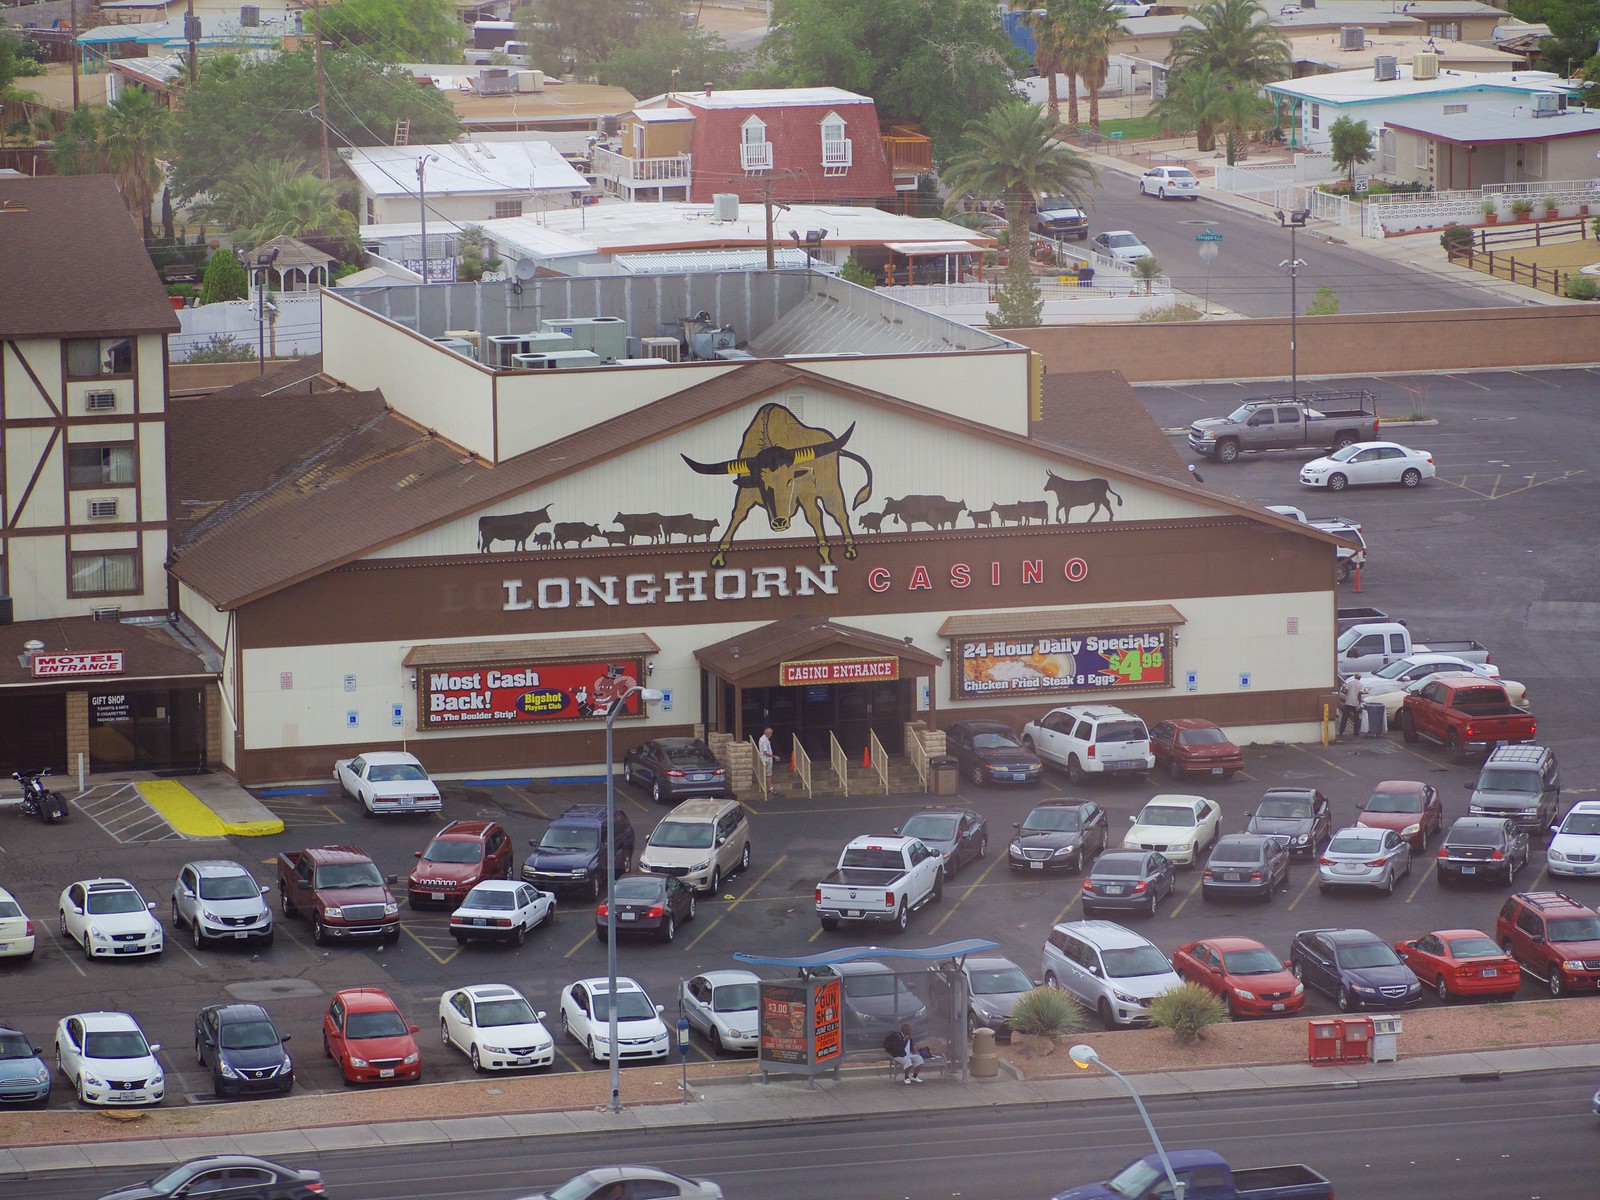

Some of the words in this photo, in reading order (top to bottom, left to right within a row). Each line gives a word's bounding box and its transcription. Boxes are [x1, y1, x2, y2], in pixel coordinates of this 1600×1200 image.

[502, 564, 839, 611] LONGHORN
[868, 558, 1088, 592] CASINO
[964, 642, 1034, 658] 24-Hour
[1038, 637, 1082, 655] Daily
[1086, 633, 1165, 654] Specials!
[39, 655, 118, 665] MOTEL
[39, 663, 118, 672] ENTRANCE
[788, 667, 828, 680] CASINO
[833, 663, 891, 677] ENTRANCE
[430, 672, 482, 691] Most
[487, 669, 540, 689] Cash
[964, 680, 1008, 691] Chicken
[1012, 678, 1040, 688] Fried
[1042, 676, 1074, 687] Steak
[1077, 675, 1085, 684] &
[1088, 674, 1115, 685] Eggs
[92, 697, 106, 705] GIFT
[108, 695, 125, 704] SHOP
[430, 691, 492, 711] Back!
[524, 693, 562, 705] Bigshot
[430, 714, 441, 722] On
[494, 710, 517, 719] Strip!
[821, 992, 836, 1008] GUN
[768, 1003, 787, 1014] $3.00
[816, 1006, 838, 1025] SHOW
[816, 1025, 826, 1036] JUNE
